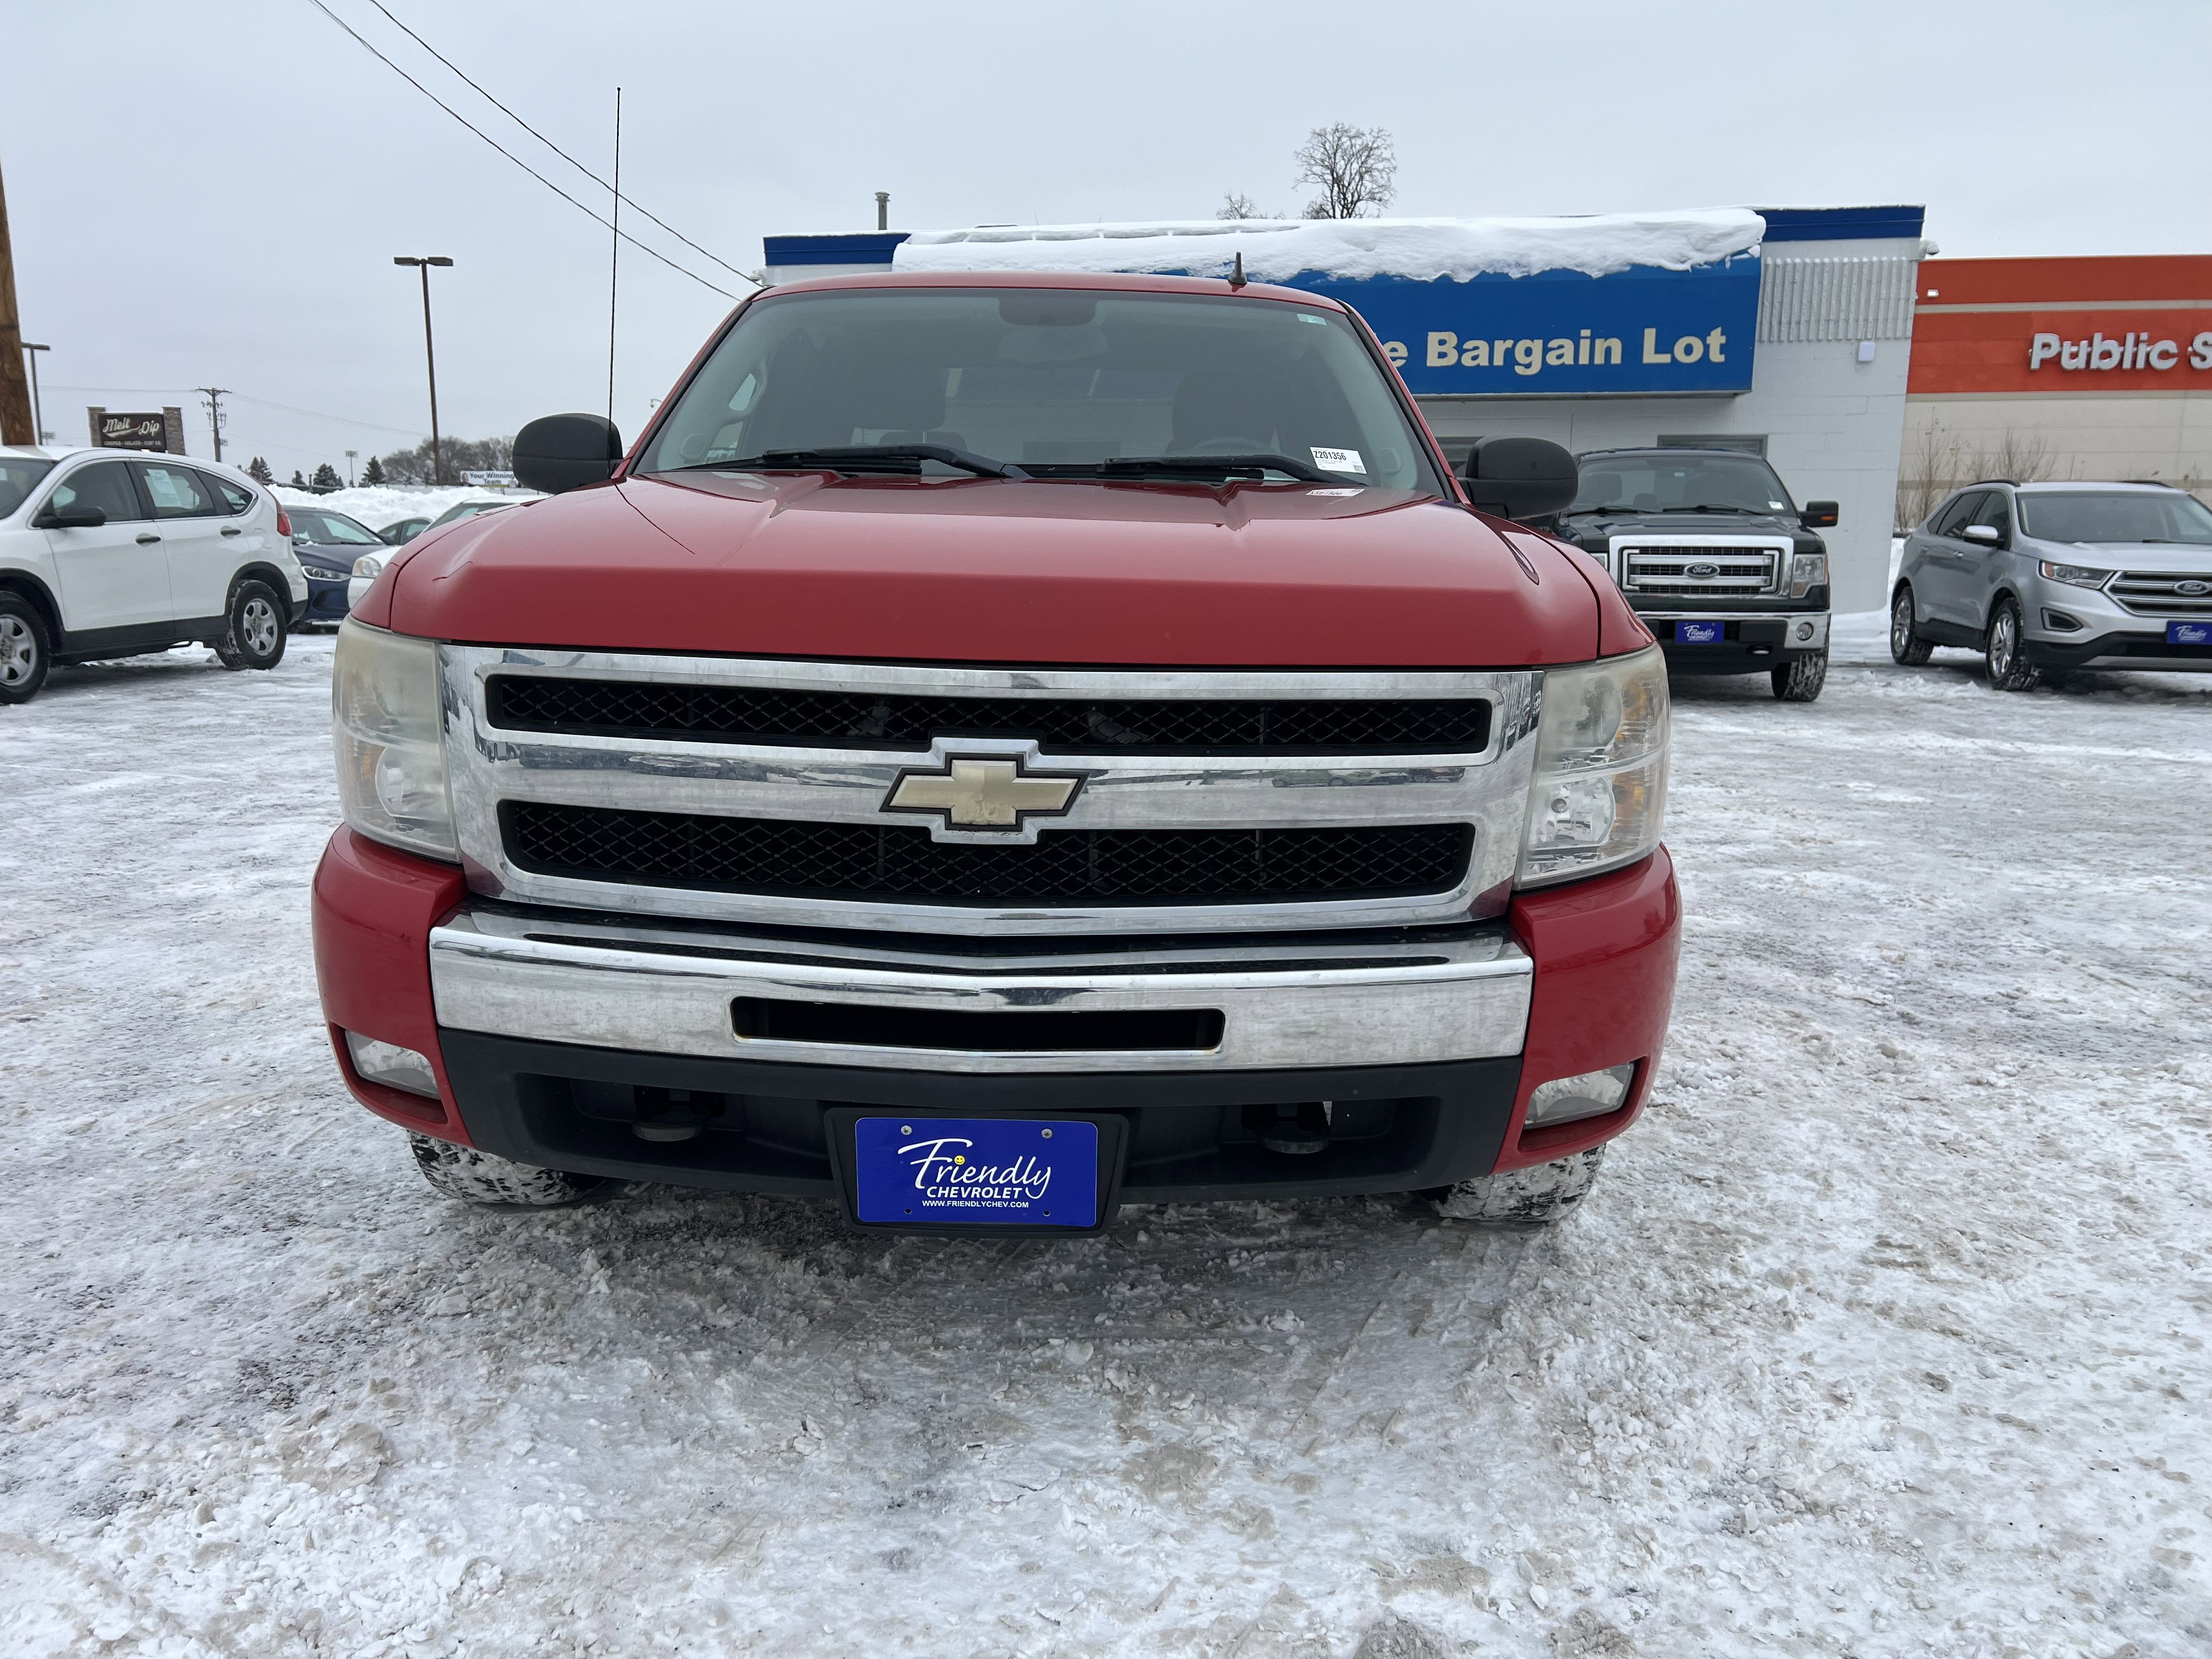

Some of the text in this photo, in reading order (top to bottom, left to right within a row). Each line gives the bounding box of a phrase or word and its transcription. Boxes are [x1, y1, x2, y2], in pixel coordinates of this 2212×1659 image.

[1427, 329, 1622, 375] Bargain
[1643, 326, 1726, 364] Lot
[2030, 332, 2179, 370] Public
[102, 417, 160, 436] Melt Dip
[1313, 450, 1347, 461] Z201356
[898, 1138, 1051, 1199] Friendly
[926, 1186, 1023, 1199] CHEVROLET
[922, 1200, 1029, 1209] WWW.FRIENDLYCHEV.COM
